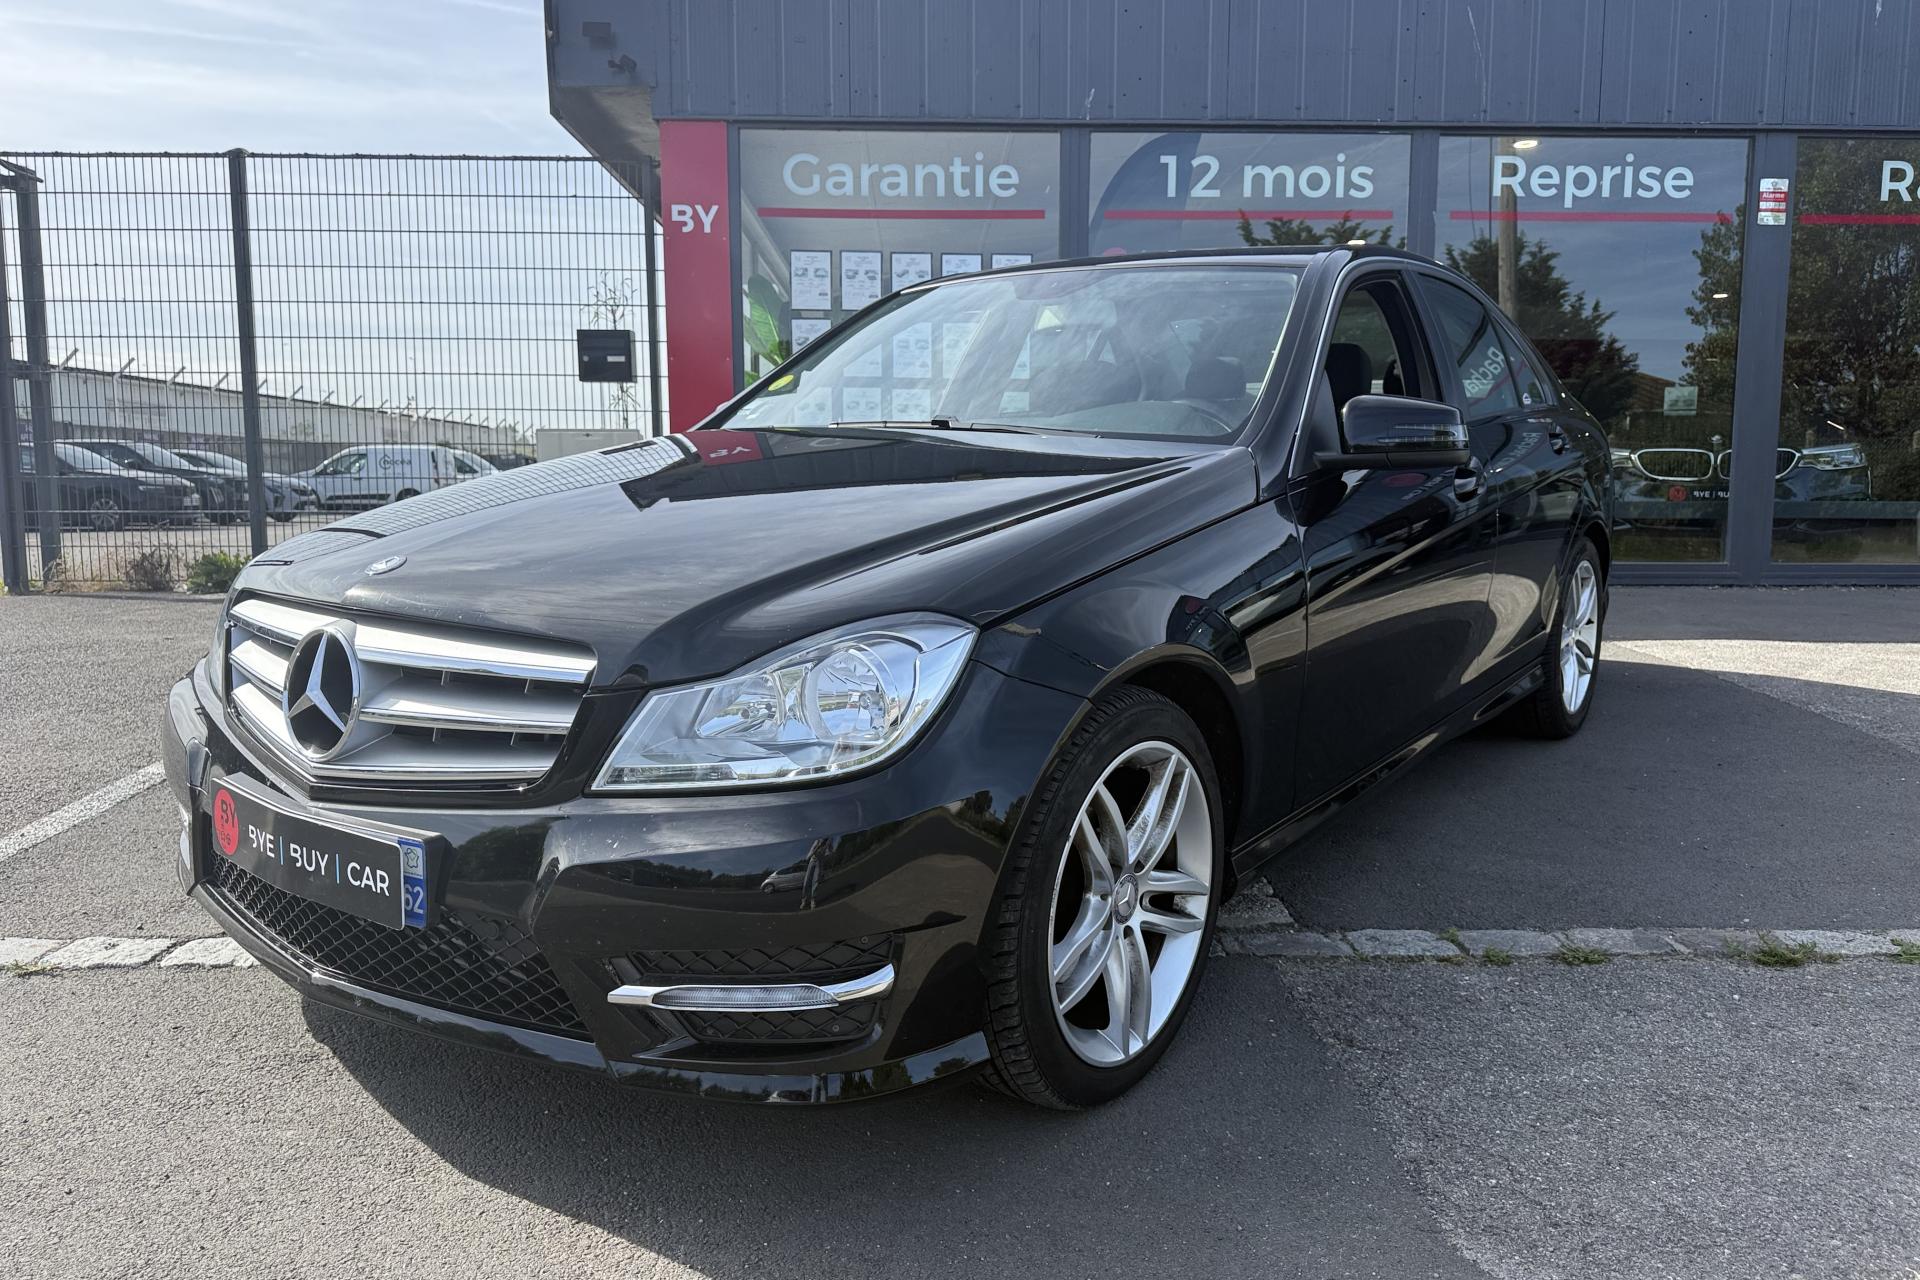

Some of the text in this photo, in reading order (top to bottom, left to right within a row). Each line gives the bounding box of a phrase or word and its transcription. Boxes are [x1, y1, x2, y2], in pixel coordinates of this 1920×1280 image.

[782, 152, 1020, 198] Garantie
[1159, 152, 1374, 199] 12 mois
[1491, 153, 1695, 209] Reprise
[1881, 160, 1920, 202] R
[1762, 191, 1785, 199] Alarme
[671, 204, 719, 233] BY
[1693, 490, 1711, 498] BYE
[1718, 490, 1730, 498] BU
[220, 799, 236, 828] BY
[248, 824, 275, 858] BYE
[289, 843, 329, 876] BUY
[347, 862, 390, 897] CAR
[404, 883, 424, 914] 62
